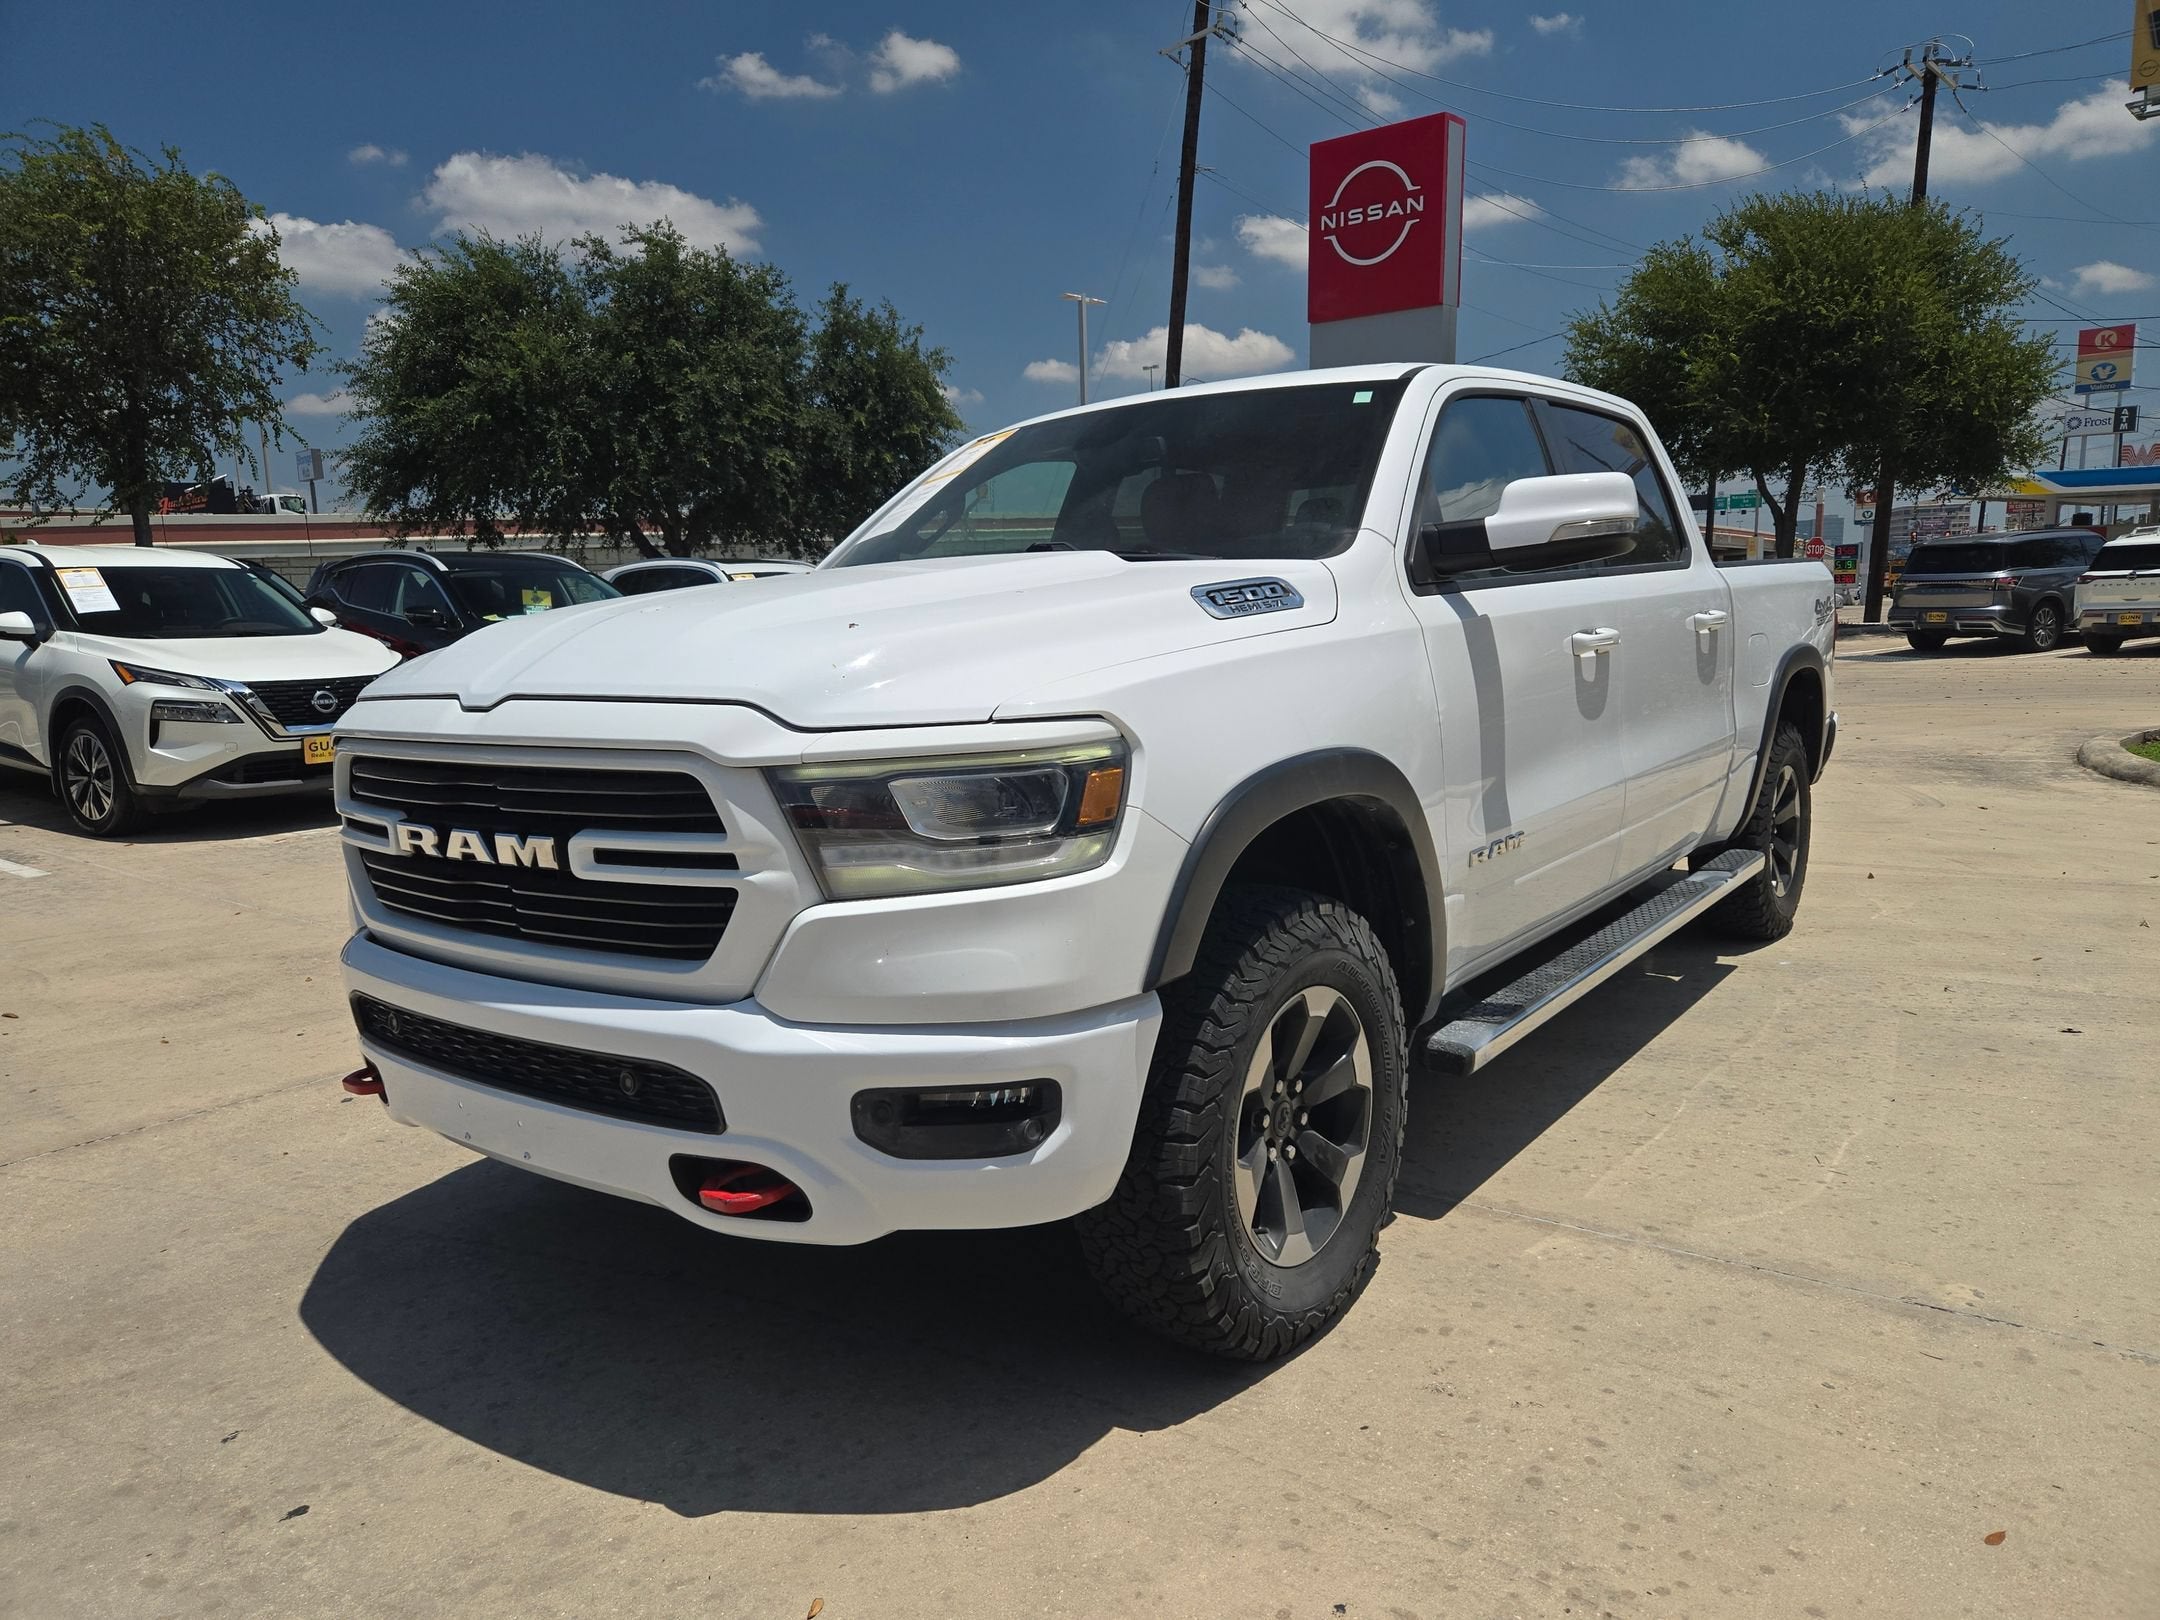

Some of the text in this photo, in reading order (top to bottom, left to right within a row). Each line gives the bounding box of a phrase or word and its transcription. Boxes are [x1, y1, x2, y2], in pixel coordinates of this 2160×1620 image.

[1321, 195, 1424, 231] NISSAN
[2101, 334, 2114, 346] K
[2090, 383, 2116, 391] Valero
[2084, 417, 2112, 427] Frost
[2119, 408, 2129, 430] ATM
[1806, 546, 1825, 555] STOP
[1208, 584, 1284, 605] 1500
[1229, 600, 1288, 613] HEMI 5.7L
[396, 821, 560, 870] RAM
[1468, 831, 1525, 868] RAM
